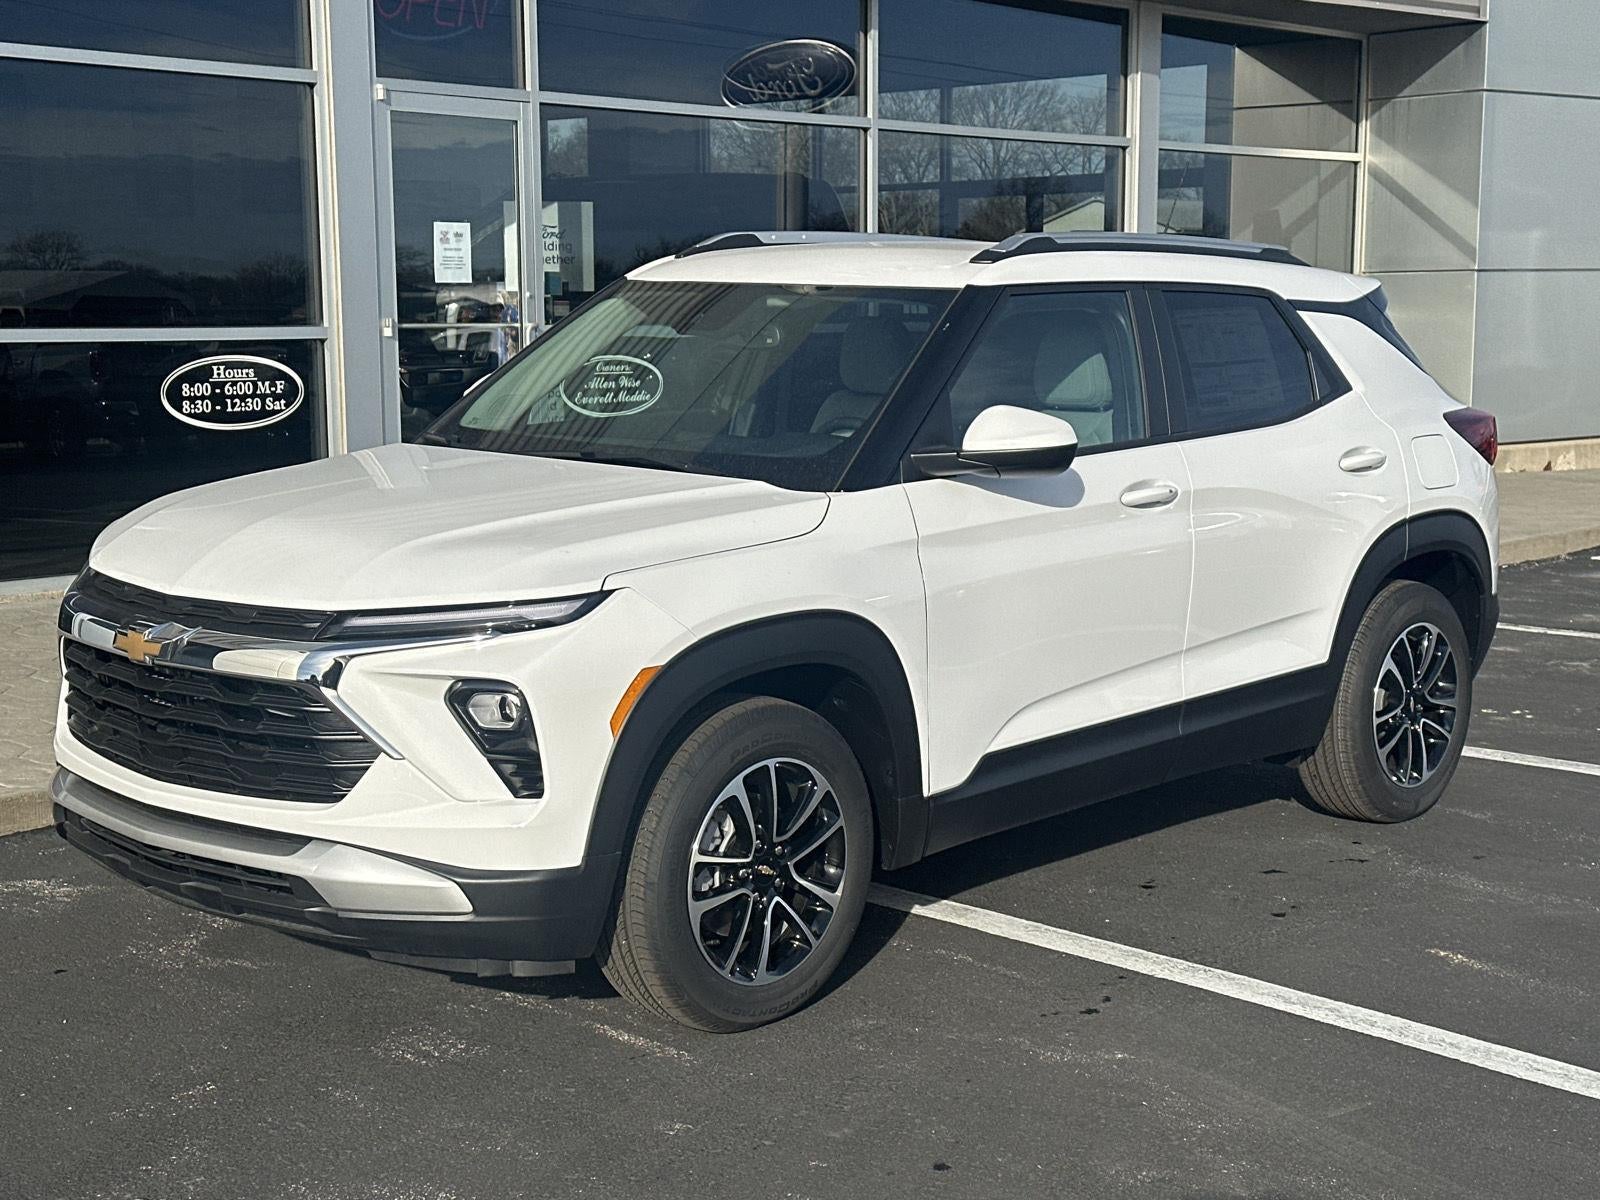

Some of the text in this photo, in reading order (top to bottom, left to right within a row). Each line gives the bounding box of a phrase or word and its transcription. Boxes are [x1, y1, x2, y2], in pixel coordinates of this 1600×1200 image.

[543, 241, 573, 253] lding
[542, 254, 576, 265] ether
[212, 365, 255, 379] Hours
[181, 382, 212, 397] 8:00
[224, 381, 253, 395] 6:00
[256, 380, 285, 394] M-F
[584, 375, 641, 389] Allen Wise
[574, 391, 614, 405] Everett
[182, 399, 212, 414] 8:30
[226, 397, 262, 412] 12:30
[265, 397, 287, 411] Sat
